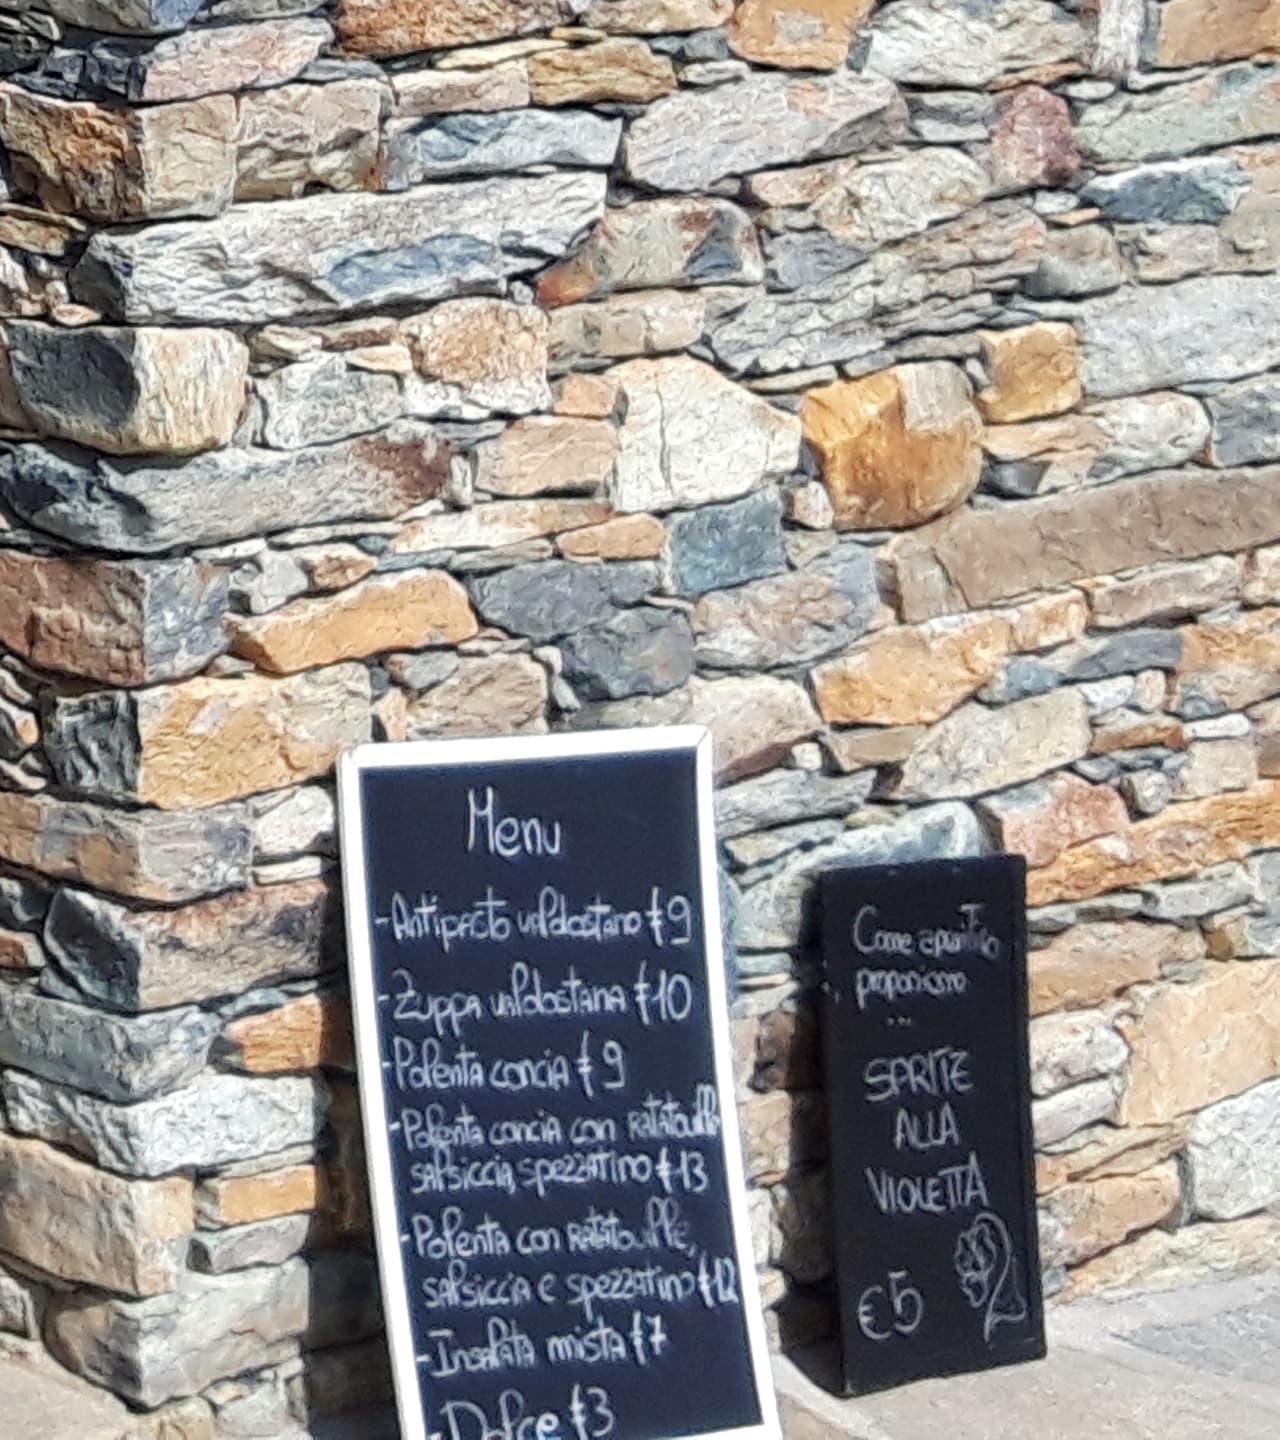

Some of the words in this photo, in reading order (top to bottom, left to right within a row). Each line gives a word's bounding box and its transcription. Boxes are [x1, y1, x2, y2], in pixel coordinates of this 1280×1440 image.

[468, 786, 561, 857] Menu
[853, 905, 913, 954] Come
[490, 962, 626, 1017] valdostana
[490, 1049, 570, 1091] concia
[863, 1047, 975, 1103] SPRITZ
[490, 1111, 561, 1145] concia
[570, 1117, 616, 1144] con
[893, 1103, 960, 1150] ALLA
[865, 1151, 990, 1215] VIOLETTA
[516, 1227, 561, 1254] con
[538, 1274, 557, 1302] e
[547, 1315, 627, 1361] mista
